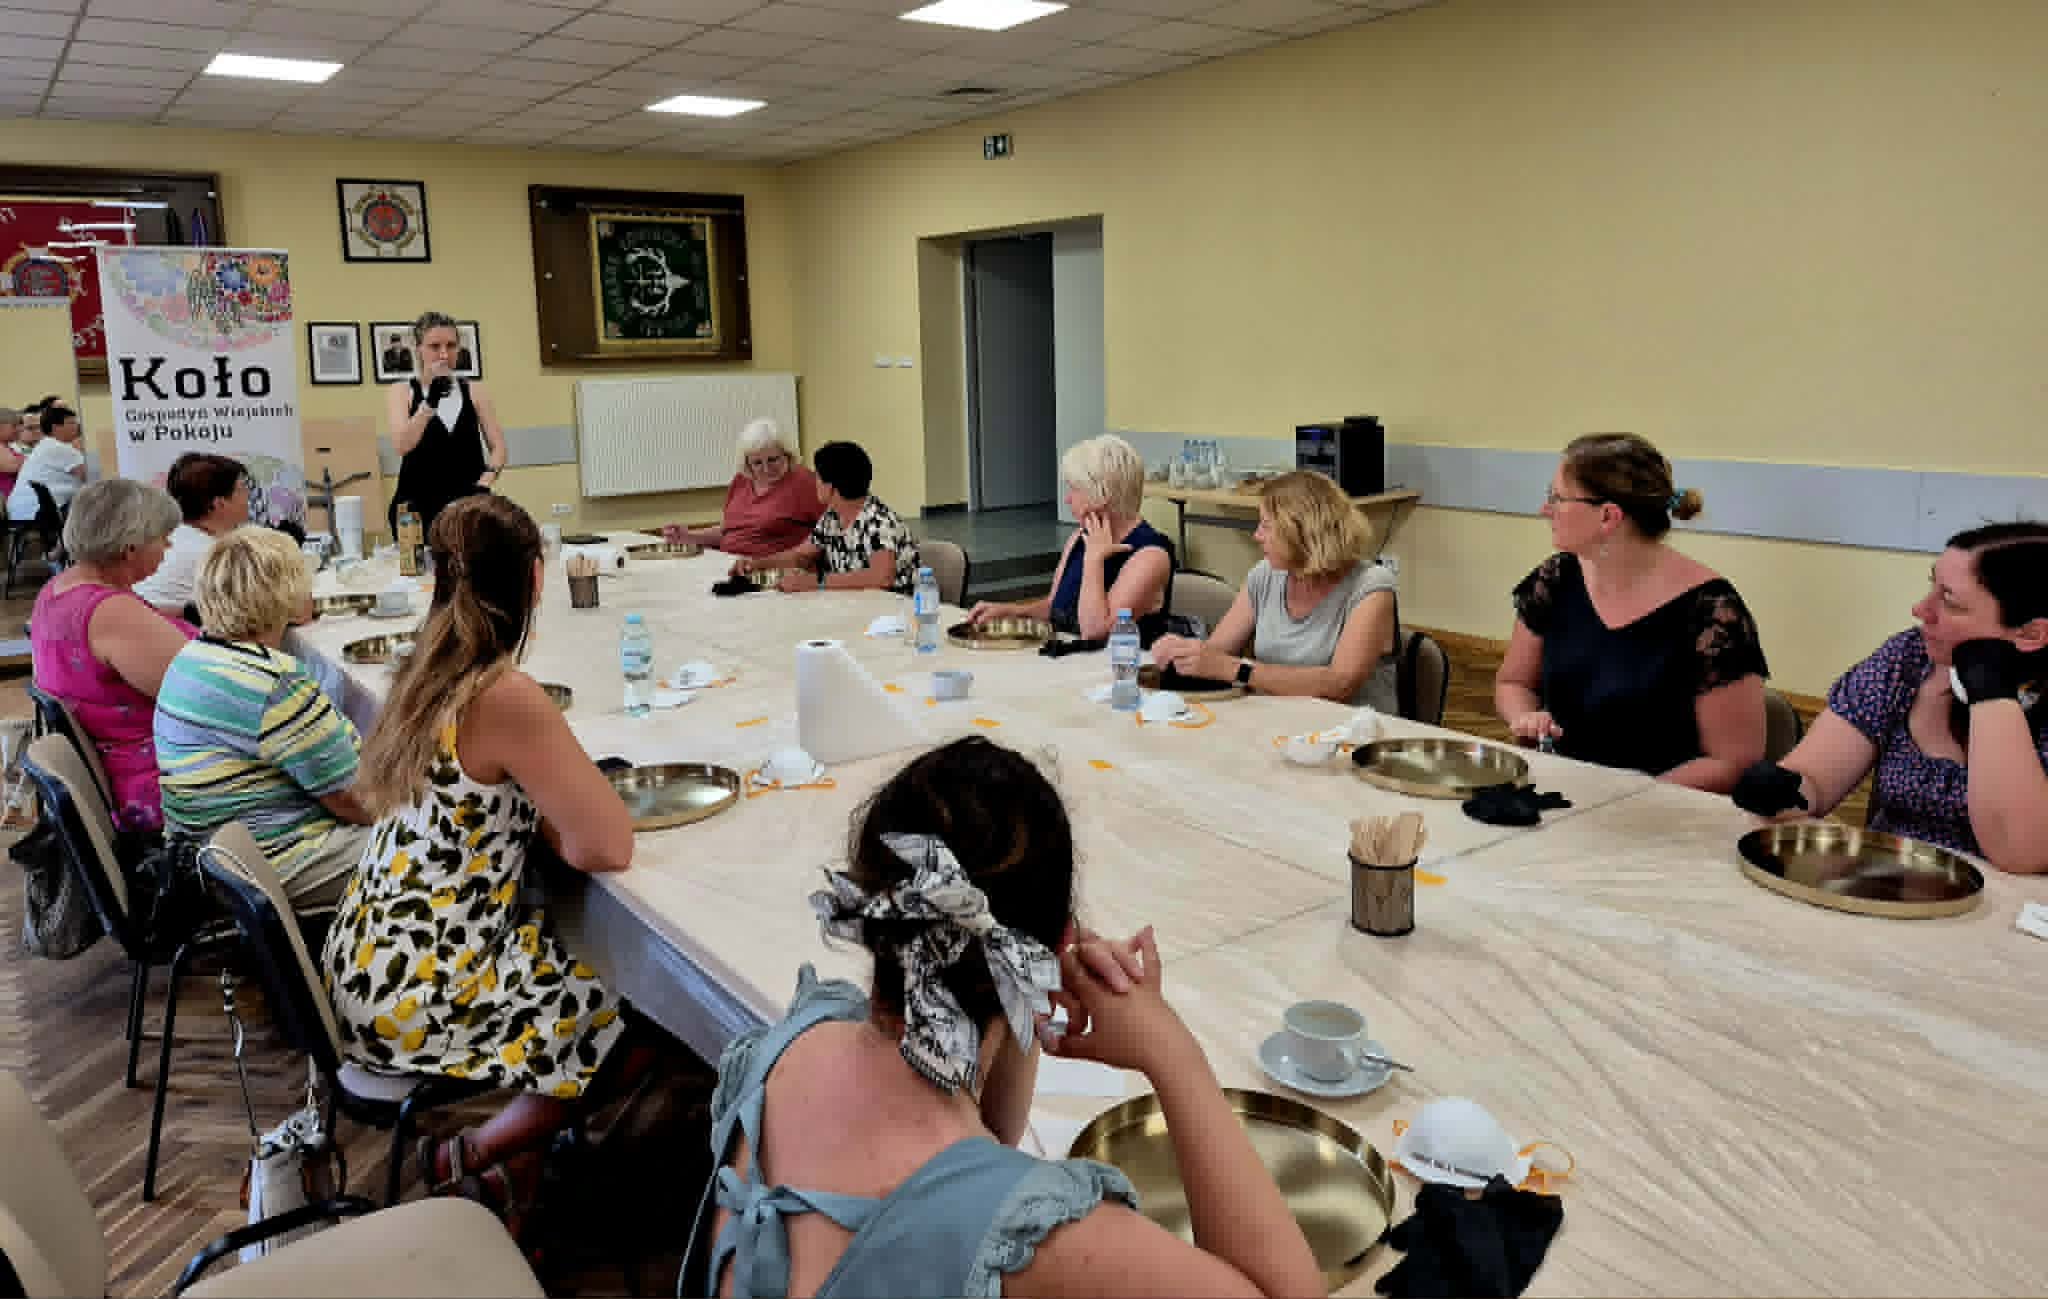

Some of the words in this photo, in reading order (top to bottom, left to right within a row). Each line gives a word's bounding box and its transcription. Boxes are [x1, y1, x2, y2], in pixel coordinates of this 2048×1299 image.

[118, 356, 271, 401] Koło
[128, 428, 145, 443] w
[153, 423, 233, 443] Pokoju
